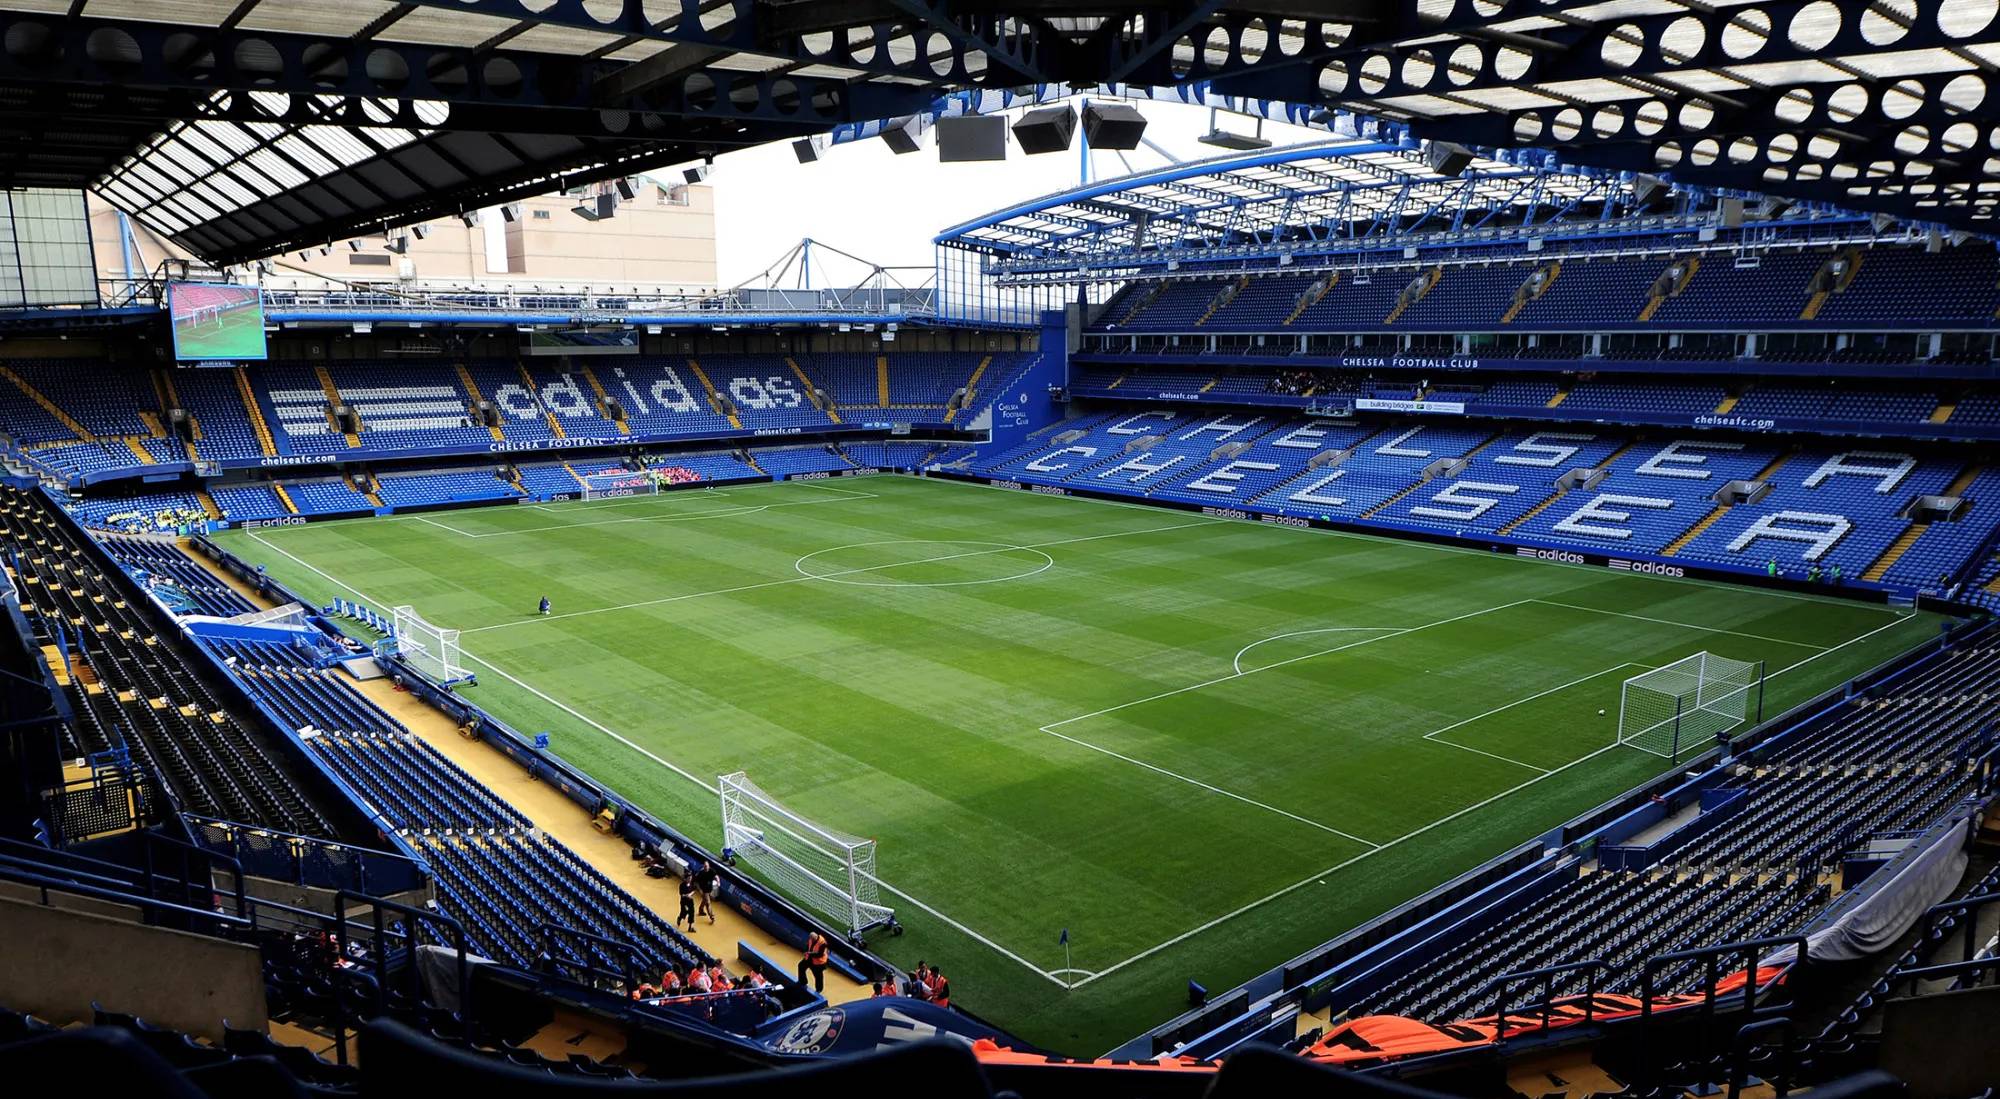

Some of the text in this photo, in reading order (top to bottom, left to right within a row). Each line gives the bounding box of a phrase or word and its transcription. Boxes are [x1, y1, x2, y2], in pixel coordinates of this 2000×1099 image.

[1342, 358, 1479, 368] CHELSEA FOOTBALL CLUB
[999, 403, 1018, 411] CHELSEA
[1370, 401, 1414, 410] building bridges
[1694, 414, 1774, 427] chelseafc.com
[754, 427, 801, 436] chelseafc.com
[490, 442, 539, 452] CHELSEA
[548, 437, 604, 449] FOOTBALL
[261, 453, 336, 466] chelseafc.com
[803, 471, 830, 480] adidas
[1041, 485, 1064, 495] adidas
[1216, 508, 1246, 519] adidas
[262, 516, 307, 528] adidas
[1275, 516, 1309, 528] adidas
[1537, 548, 1584, 564] adidas
[1632, 562, 1684, 577] adidas
